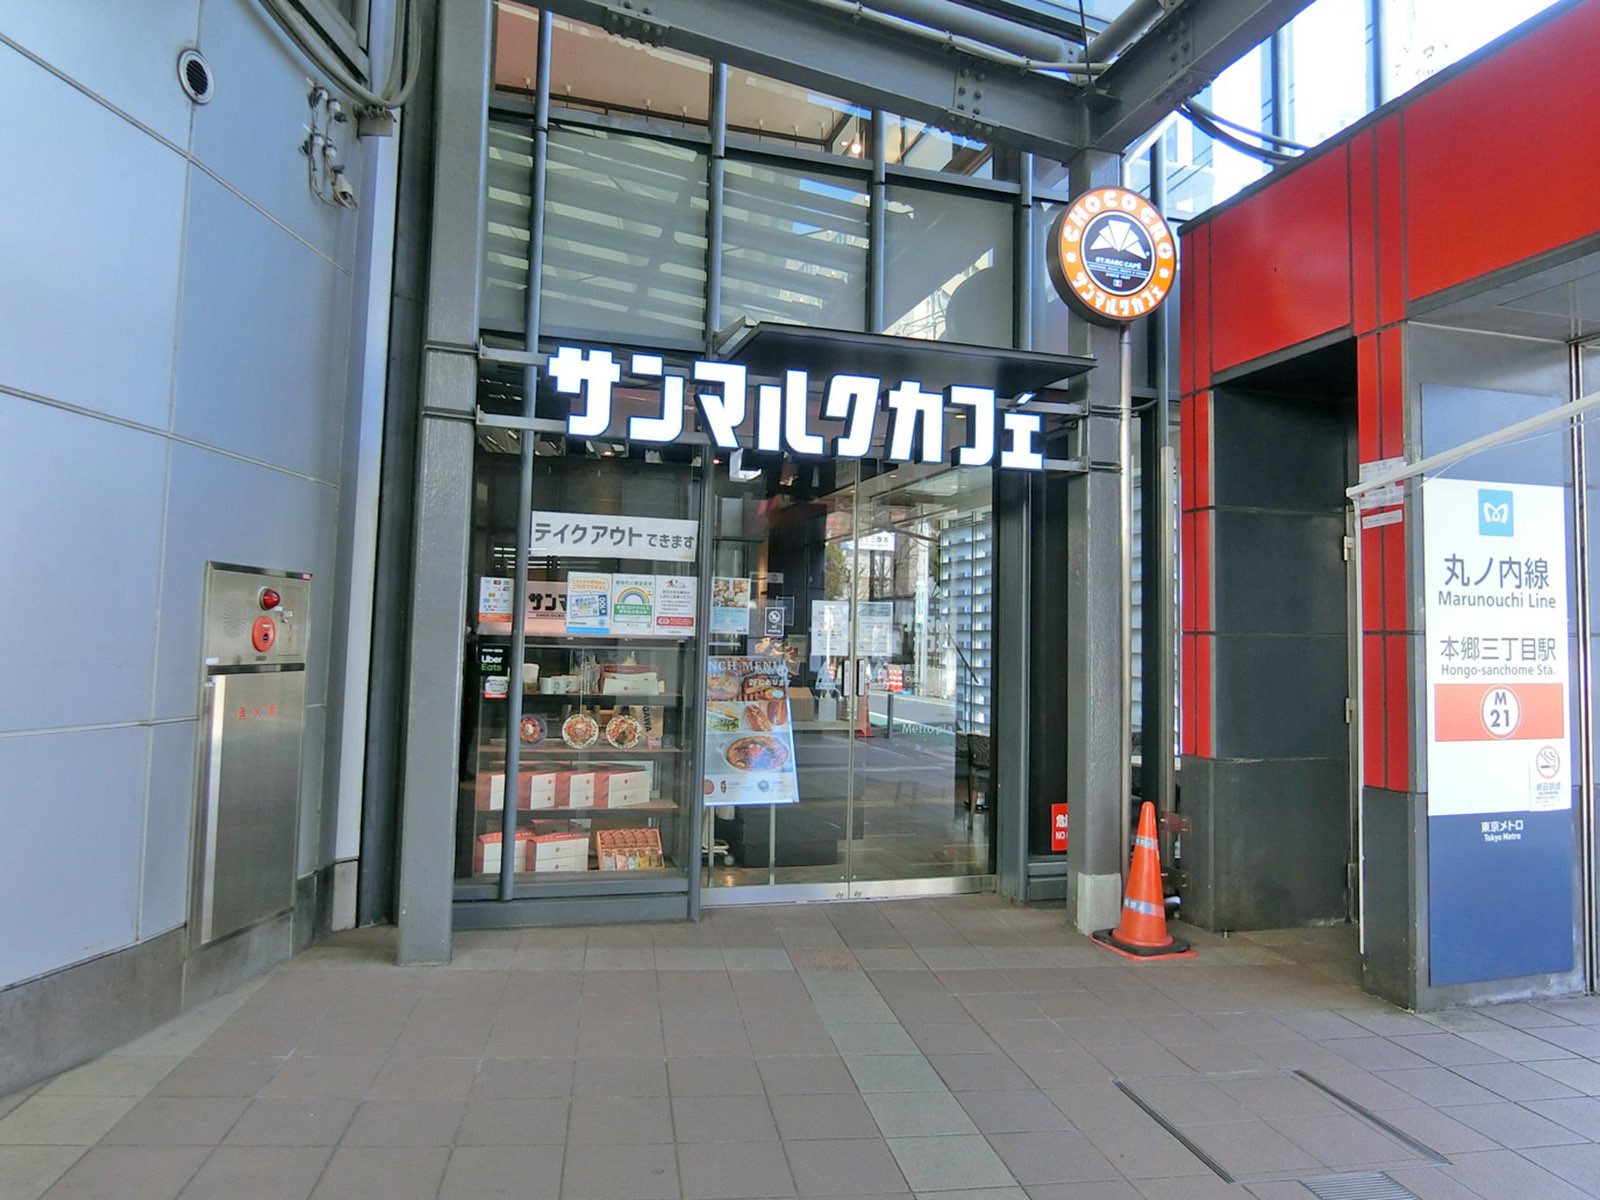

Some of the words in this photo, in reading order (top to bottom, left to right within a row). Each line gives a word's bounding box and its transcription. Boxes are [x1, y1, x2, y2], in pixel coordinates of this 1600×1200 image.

[547, 346, 1044, 470] サンマルクカフェ
[1444, 554, 1549, 590] 丸ノ内線
[1438, 590, 1524, 609] Marunouchi
[1529, 593, 1556, 609] Line
[1440, 636, 1556, 662] 本郷三丁目駅
[481, 655, 503, 663] Uber
[481, 663, 502, 671] Eats
[1441, 664, 1534, 679] Hongo-sanchome
[1537, 665, 1556, 676] Sta.
[1494, 692, 1507, 705] M
[1490, 709, 1510, 728] 21
[1481, 820, 1523, 833] 東京メトロ
[1484, 833, 1502, 843] Tokyo
